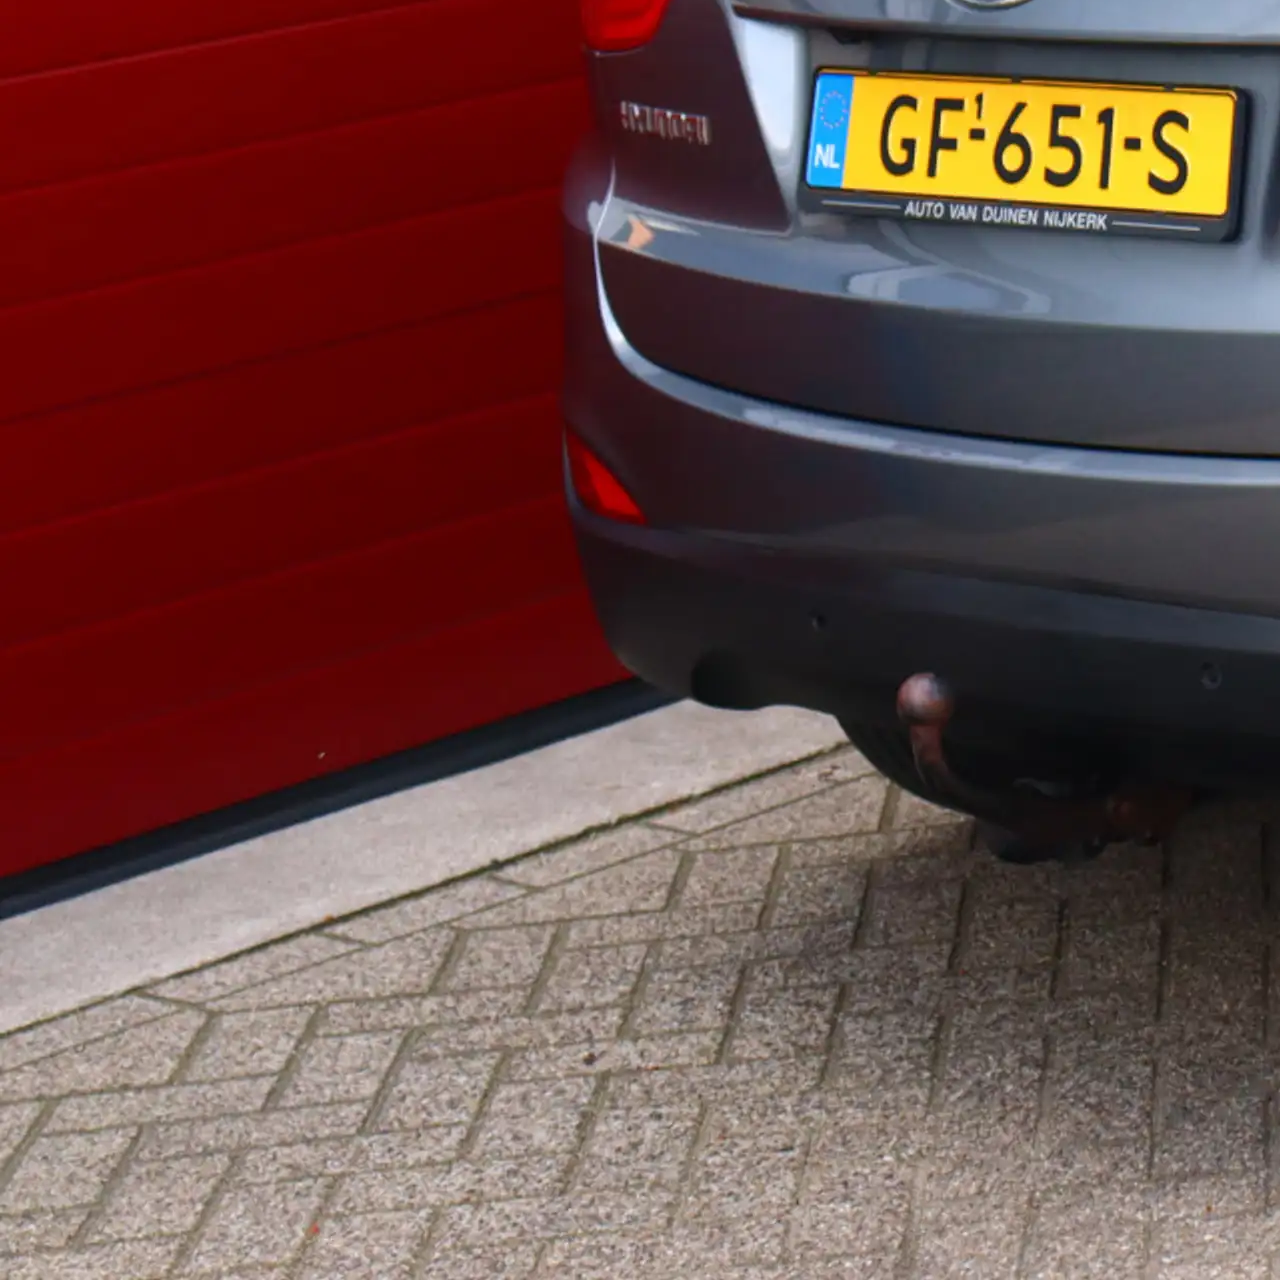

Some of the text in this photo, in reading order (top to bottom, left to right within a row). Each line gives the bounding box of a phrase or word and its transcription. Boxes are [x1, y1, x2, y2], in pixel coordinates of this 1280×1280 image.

[813, 143, 841, 170] NL
[904, 200, 1108, 231] AUTO VAN DUINEN NIJKERK
